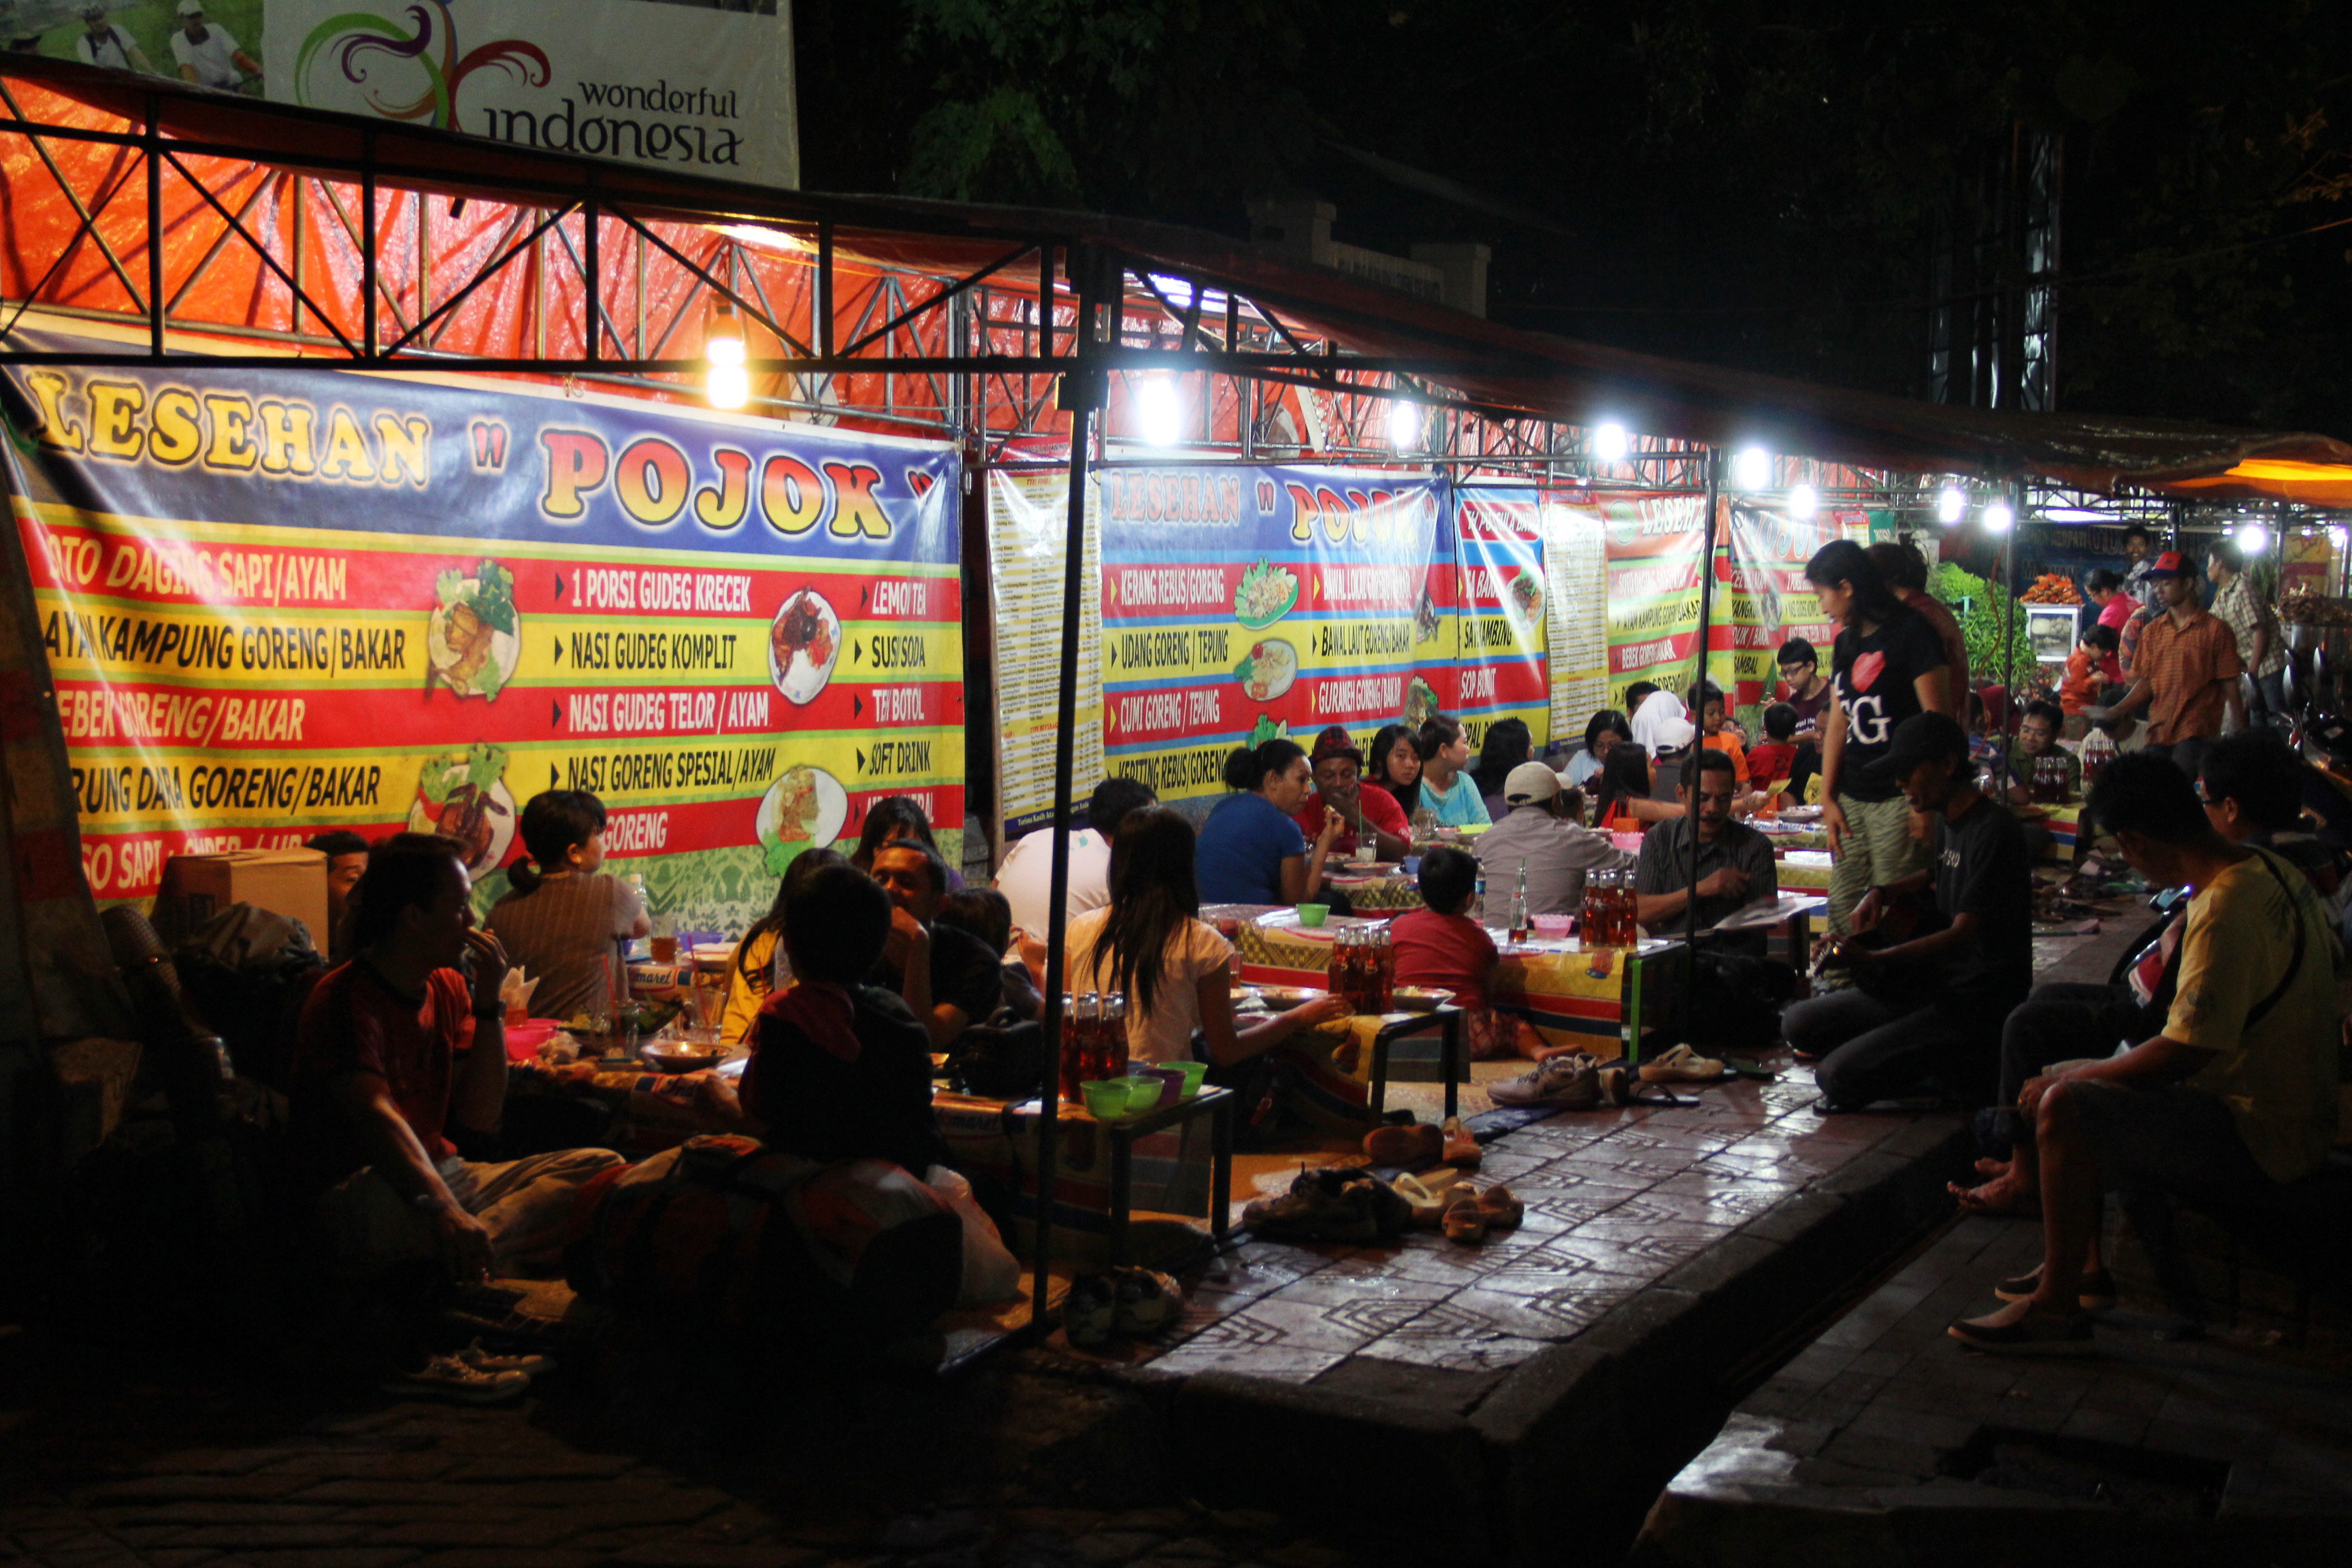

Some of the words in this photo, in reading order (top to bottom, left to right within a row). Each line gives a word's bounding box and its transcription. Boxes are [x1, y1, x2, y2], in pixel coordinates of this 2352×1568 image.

[578, 80, 739, 120] wonderful
[482, 99, 744, 167] indonesia
[26, 372, 431, 489] LESEHAN
[541, 427, 892, 539] POJOK
[1111, 472, 1240, 525] LESEHAN
[1638, 496, 1706, 536] LESEHA
[47, 534, 103, 585] OTO
[220, 550, 346, 608] SAPI/AYAM
[572, 570, 583, 606] 1
[586, 570, 637, 610] PORSI
[640, 572, 691, 611] GUDEG
[695, 574, 752, 612] KRECEK
[1122, 570, 1156, 606] KERANG
[1159, 568, 1224, 610] REBUS/GORENG
[1324, 568, 1346, 600] BAWAL
[99, 615, 234, 669] KAMPUNG
[242, 622, 406, 678] GORENG/BAKAR
[571, 633, 610, 669] NASI
[615, 634, 667, 669] GUDEG
[671, 634, 737, 670] KOMPLIT
[901, 636, 926, 668] SODA
[1122, 634, 1152, 669] UDANG
[1154, 631, 1189, 668] GORENG
[1198, 630, 1228, 664] TEPUNG
[1322, 625, 1347, 657] BAWAL
[1348, 624, 1365, 656] LAUT
[1365, 623, 1410, 659] GORENG/BAKAR
[1478, 619, 1512, 647] KAMBING
[1622, 646, 1639, 670] BEBEK
[872, 689, 892, 723] TE
[893, 687, 925, 722] BOTOL
[1319, 679, 1354, 715] GURAMEH
[1356, 676, 1402, 715] GORENG/BAKAR
[1460, 670, 1476, 700] SOP
[118, 693, 306, 747] GORENG/BAKAR
[568, 695, 608, 733] NASI
[612, 693, 665, 732] GUDEG
[670, 691, 714, 729] TELOR
[728, 691, 769, 728] AYAM
[1120, 697, 1144, 734] CUMI
[1145, 693, 1181, 731] GORENG
[1189, 689, 1220, 726] TEPUNG
[568, 755, 606, 793] NASI
[612, 753, 672, 791] GORENG
[676, 747, 776, 791] SPESIAL/AYAM
[869, 743, 895, 776] SOFT
[897, 740, 931, 773] DRINK
[137, 765, 185, 811] DARA
[189, 764, 381, 815] GORENG/BAKAR
[604, 812, 668, 852] GORENG
[118, 838, 163, 889] SAPI
